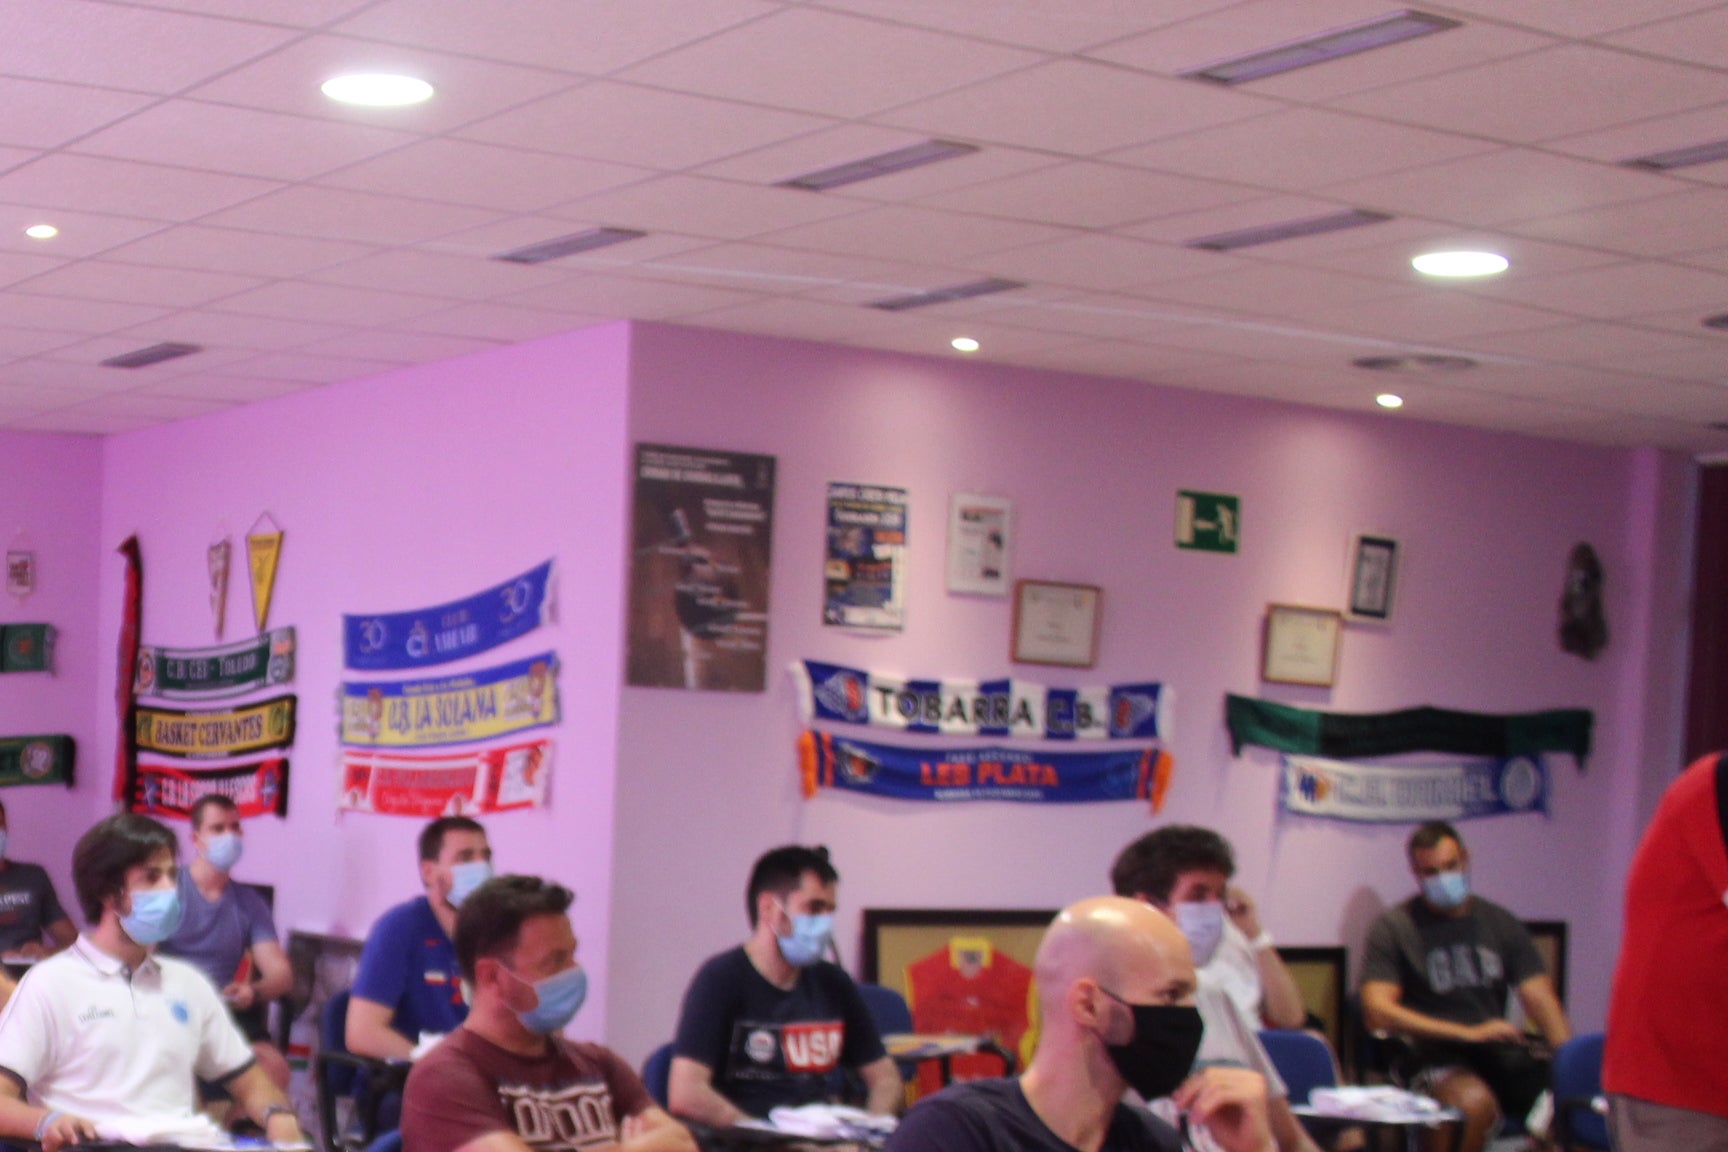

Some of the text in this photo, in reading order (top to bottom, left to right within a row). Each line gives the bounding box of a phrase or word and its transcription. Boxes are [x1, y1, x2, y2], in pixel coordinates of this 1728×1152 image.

[873, 685, 1034, 729] TOBARRA
[155, 713, 264, 747] BASKET CERVANTES
[976, 760, 1059, 787] PLATA
